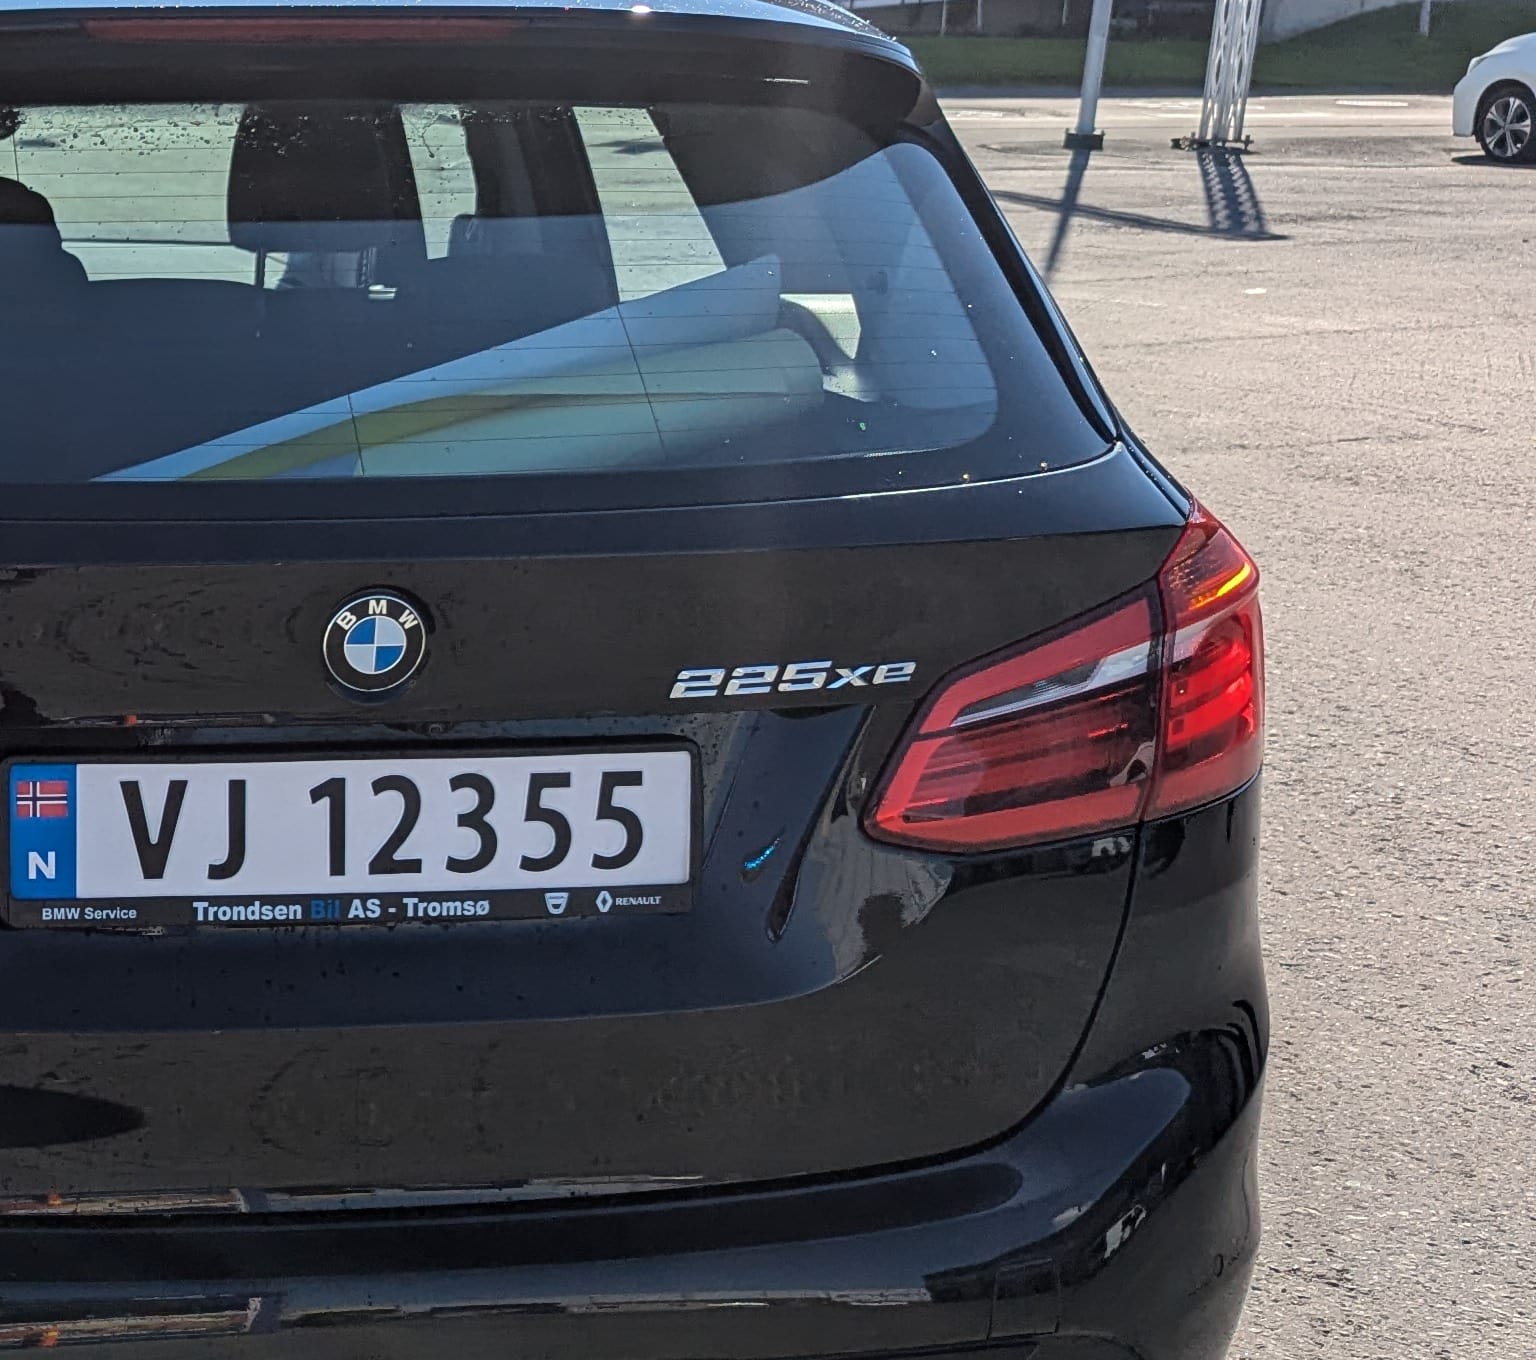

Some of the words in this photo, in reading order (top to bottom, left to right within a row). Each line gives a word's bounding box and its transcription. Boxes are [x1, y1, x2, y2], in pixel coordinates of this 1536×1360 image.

[336, 599, 418, 631] BMW
[669, 660, 916, 699] 225xe
[119, 779, 247, 880] VJ
[309, 770, 644, 877] 12355
[28, 851, 56, 880] N
[42, 907, 81, 921] BMW
[84, 906, 137, 920] Service
[193, 900, 302, 922] Trondsen
[310, 899, 341, 920] Bil
[348, 898, 381, 919] AS
[402, 896, 490, 918] Tromsø
[615, 896, 662, 906] RENAULT
